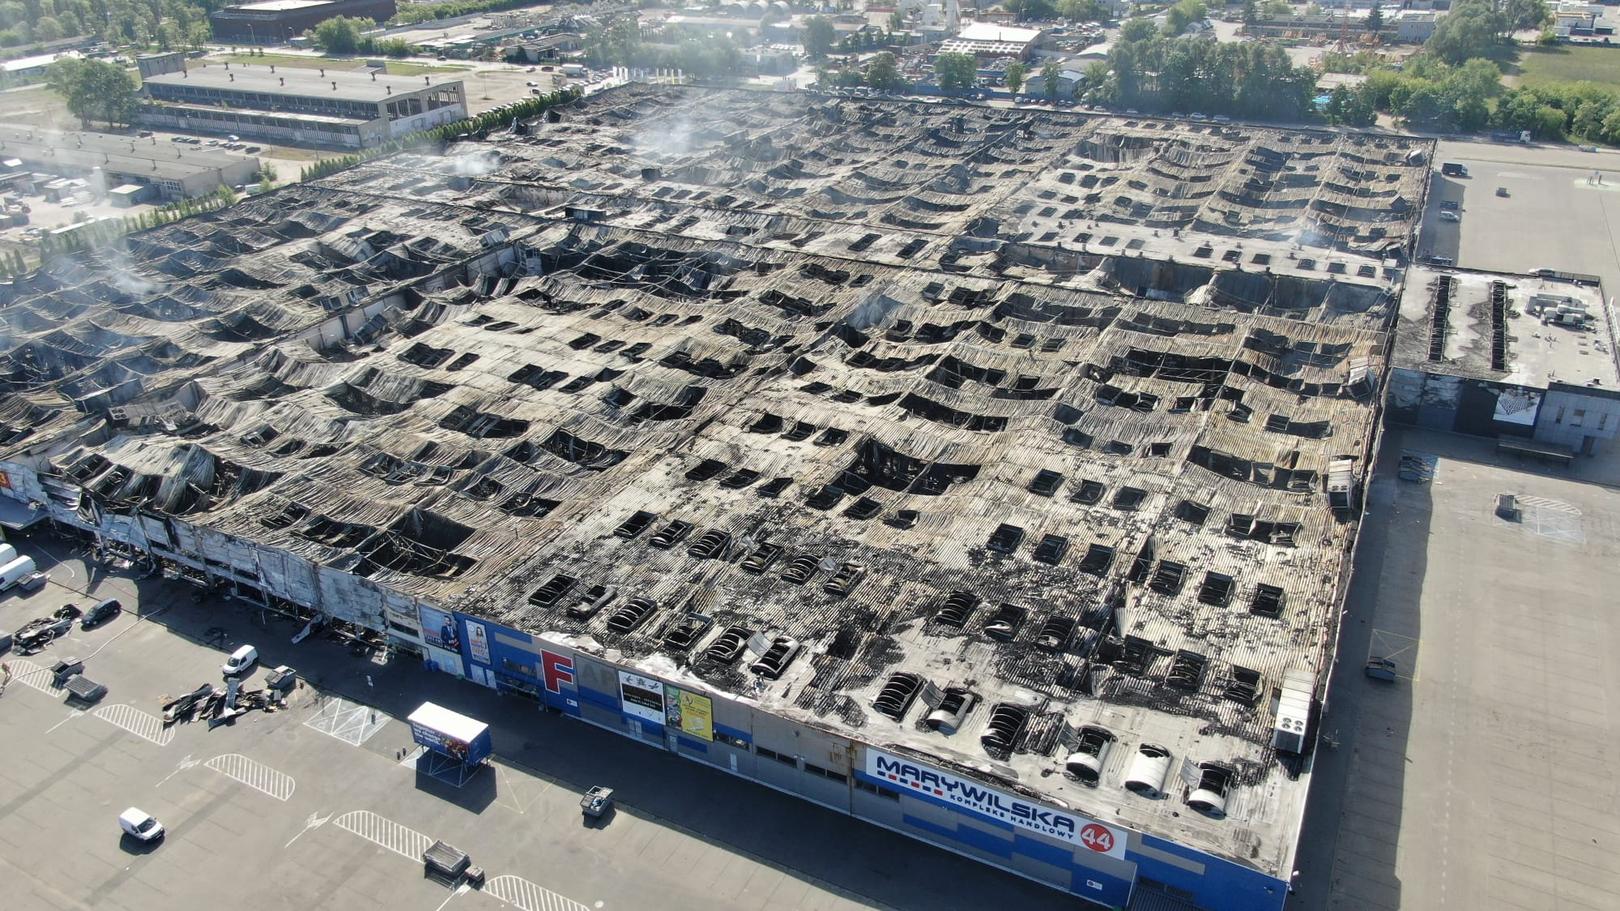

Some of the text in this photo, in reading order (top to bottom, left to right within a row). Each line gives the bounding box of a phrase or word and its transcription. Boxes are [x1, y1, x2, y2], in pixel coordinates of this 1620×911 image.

[540, 648, 574, 694] F
[876, 756, 1075, 833] MARYWILSKA
[950, 794, 1005, 818] KOMPLEKS
[1081, 827, 1111, 851] 44
